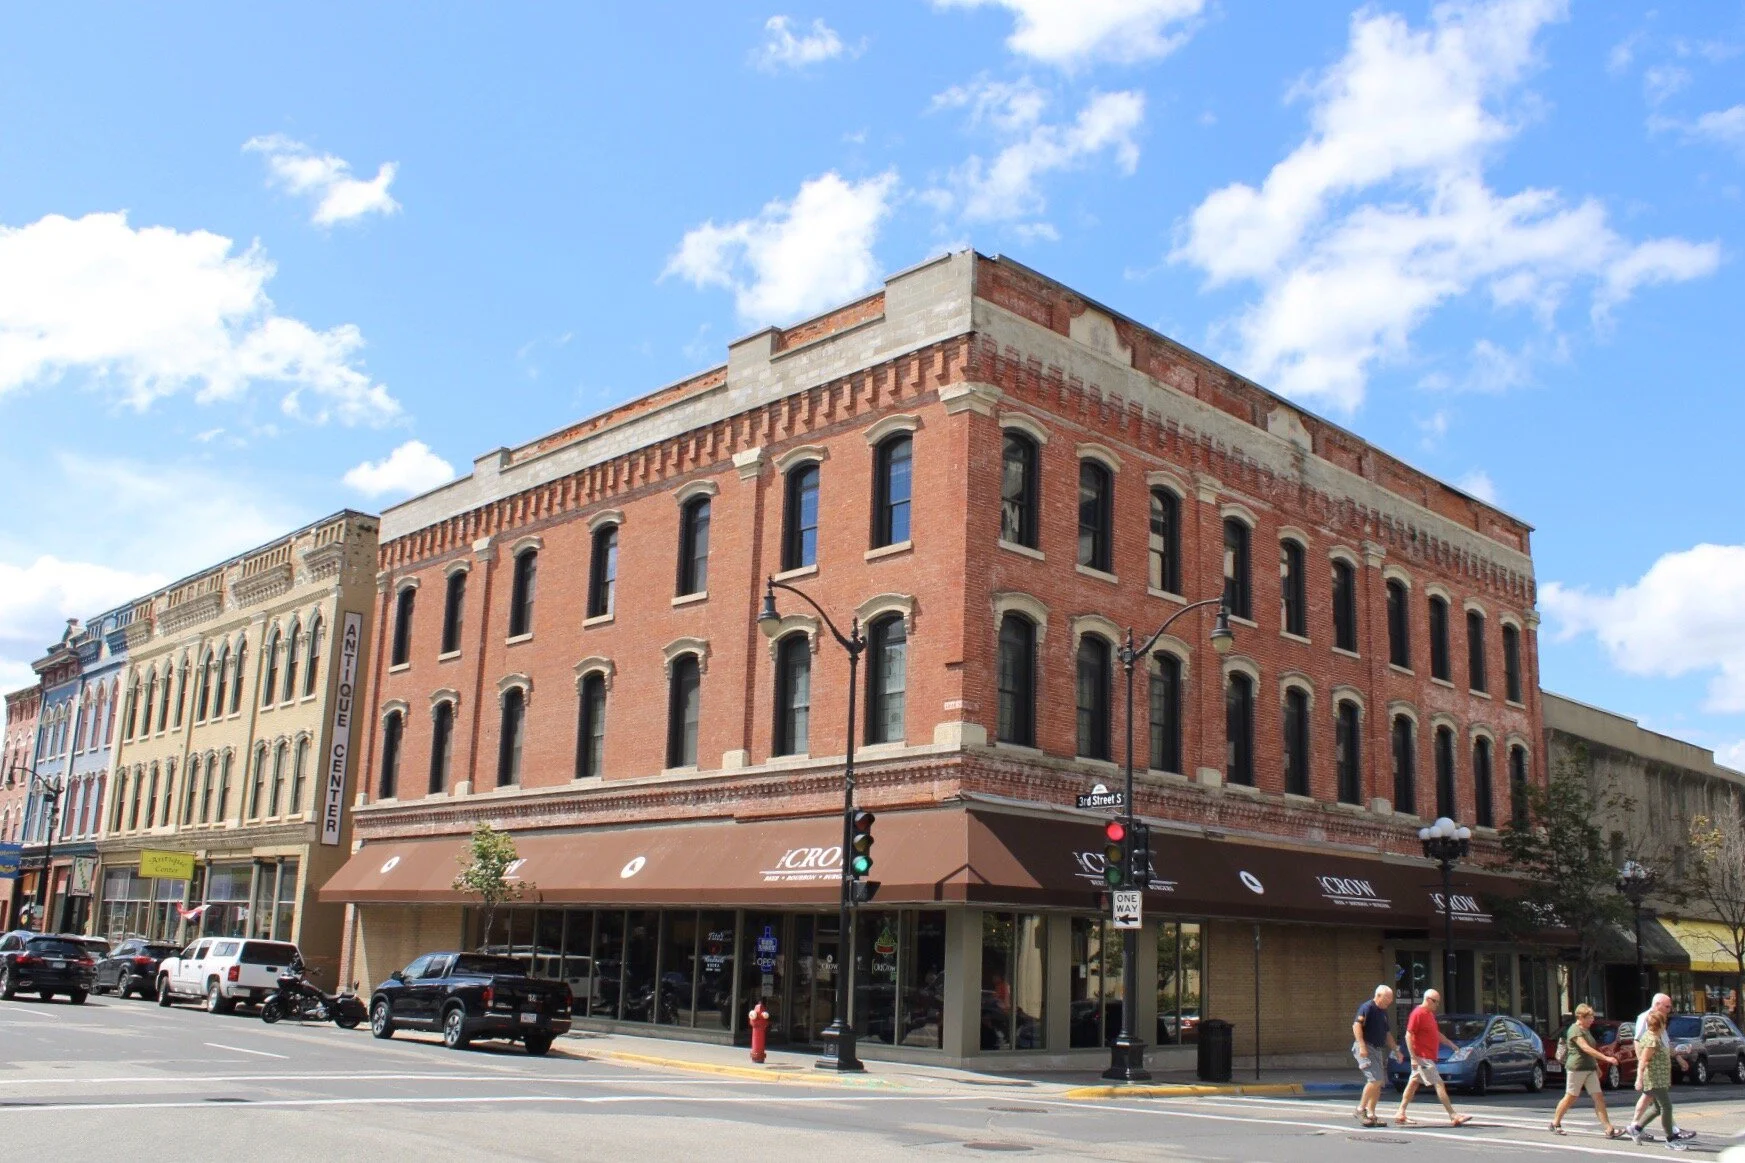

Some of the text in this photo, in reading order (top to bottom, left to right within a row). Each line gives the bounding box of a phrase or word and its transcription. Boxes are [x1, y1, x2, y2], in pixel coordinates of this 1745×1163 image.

[326, 623, 357, 833] ANTIQUE CENTER
[1078, 796, 1091, 806] 3rd
[1092, 793, 1115, 805] Street
[785, 846, 843, 868] CRO
[1322, 876, 1376, 896] CROW
[1116, 894, 1137, 903] ONE
[1116, 905, 1138, 913] WAY
[757, 958, 776, 966] OPEN
